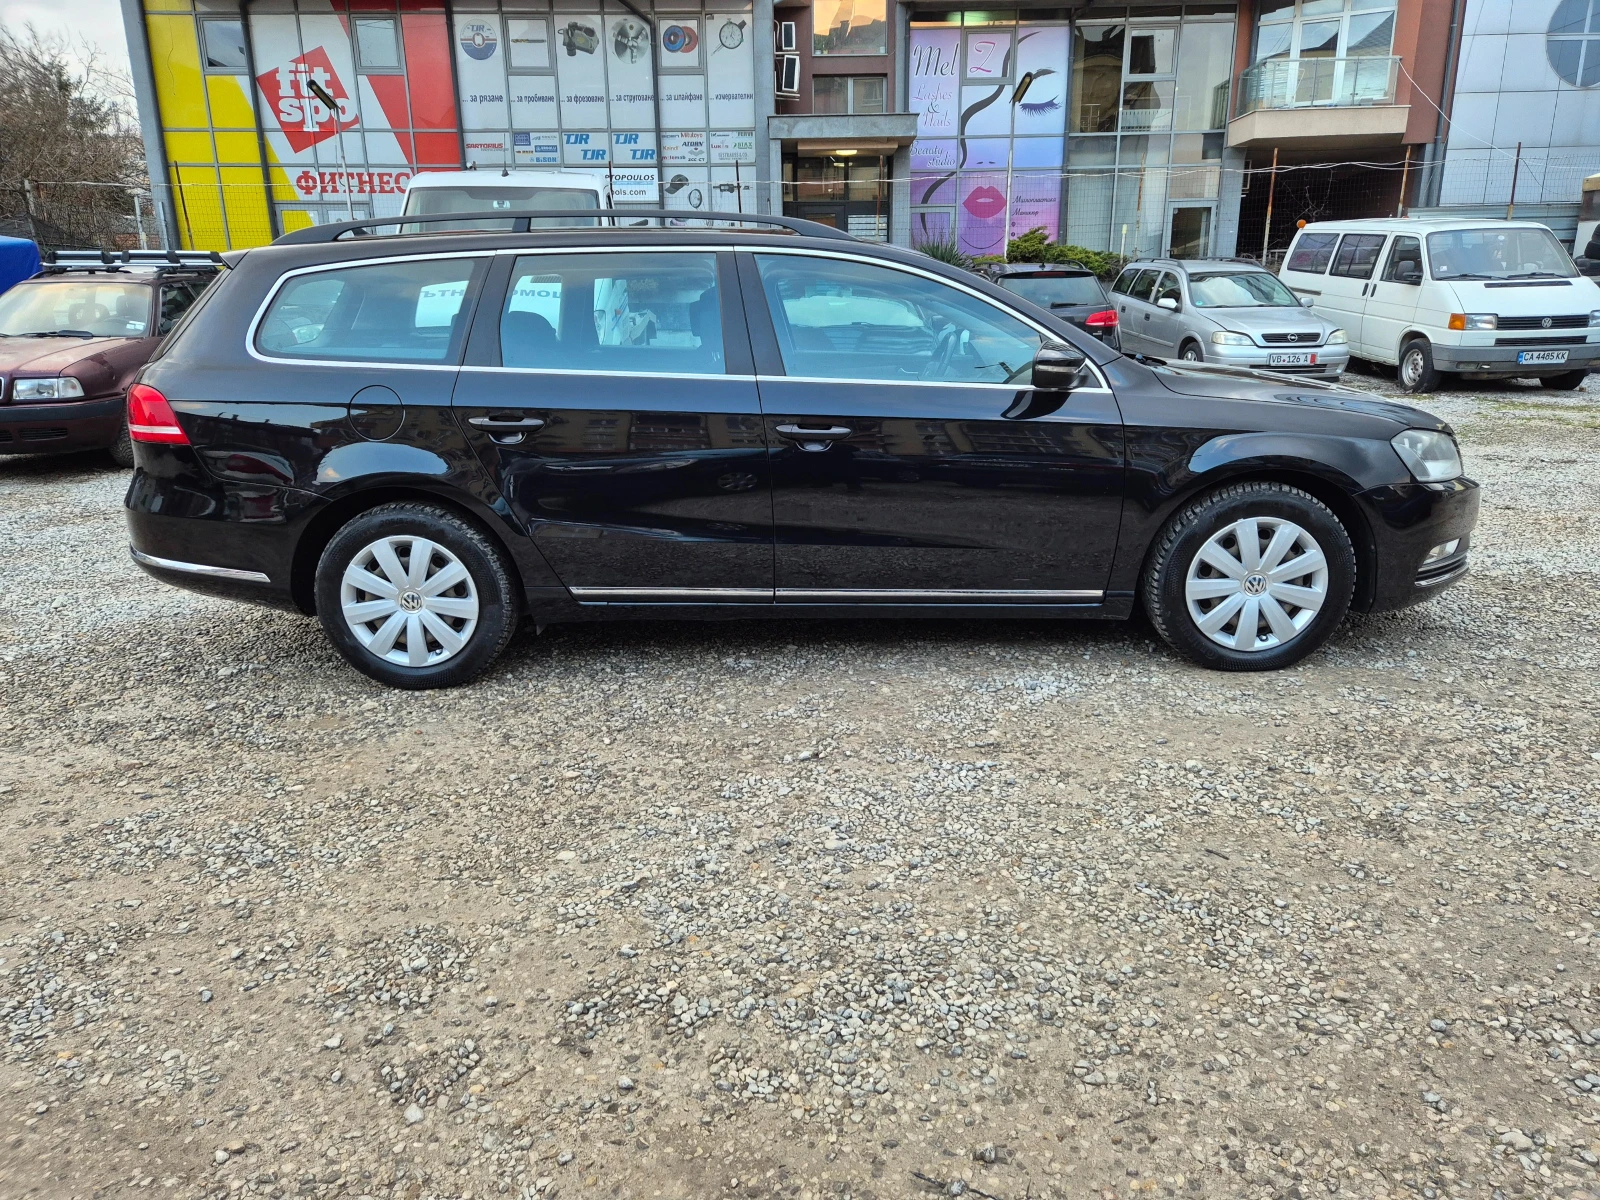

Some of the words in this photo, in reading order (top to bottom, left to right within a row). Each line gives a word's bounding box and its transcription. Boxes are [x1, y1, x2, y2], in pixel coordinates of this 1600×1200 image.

[913, 43, 959, 77] Mel
[969, 40, 996, 74] Z
[276, 61, 334, 97] fit
[666, 93, 672, 101] за
[674, 92, 703, 102] шлайфане
[911, 82, 953, 102] Lashes
[470, 94, 478, 102] за
[479, 94, 504, 104] рязане
[516, 94, 523, 102] за
[524, 93, 554, 104] пробиване
[566, 94, 572, 102] за
[573, 94, 604, 104] фрезоване
[616, 94, 622, 102] за
[278, 97, 358, 132] spo
[564, 134, 590, 144] TJR
[613, 134, 640, 144] TJR
[630, 148, 656, 160] TJR
[910, 141, 944, 156] Beauty
[580, 149, 606, 160] TJR
[927, 152, 956, 167] studio
[296, 170, 410, 195] ФИТНЕС
[1524, 352, 1534, 361] CA
[1536, 352, 1554, 360] 4485
[1556, 352, 1566, 360] KK
